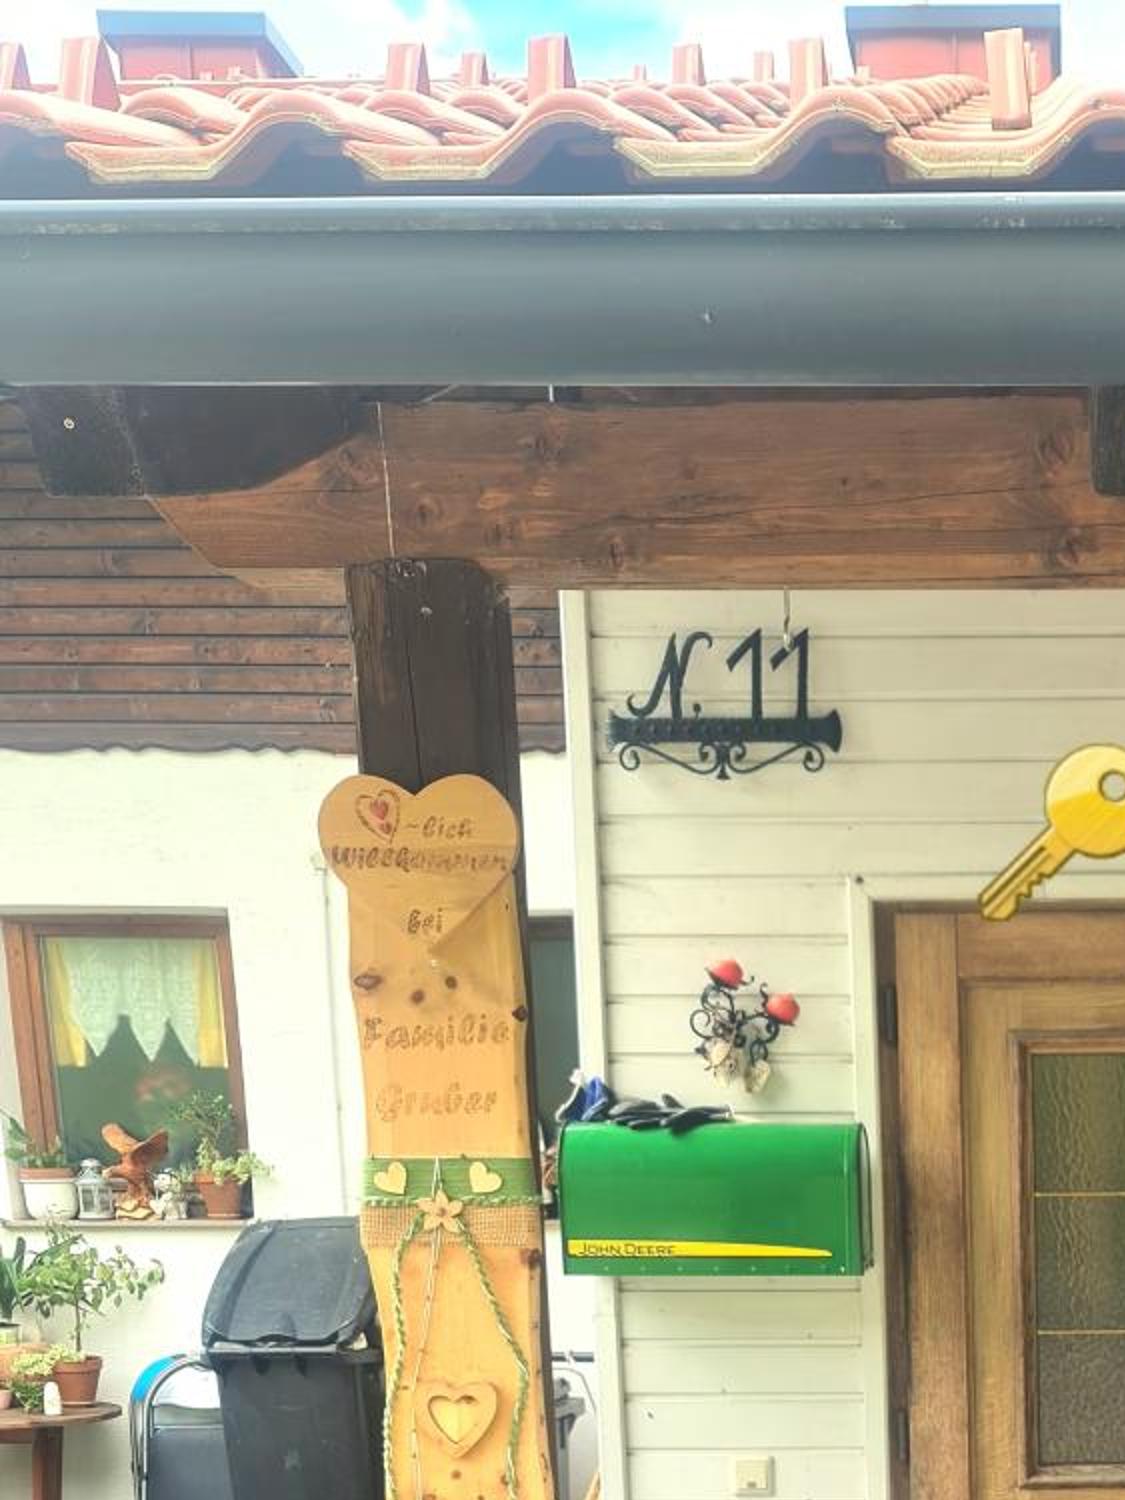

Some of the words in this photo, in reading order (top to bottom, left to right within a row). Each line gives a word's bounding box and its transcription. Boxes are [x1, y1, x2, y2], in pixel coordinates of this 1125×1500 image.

[726, 628, 809, 720] 11
[364, 1013, 510, 1049] Familie
[623, 1243, 676, 1255] DEERE
